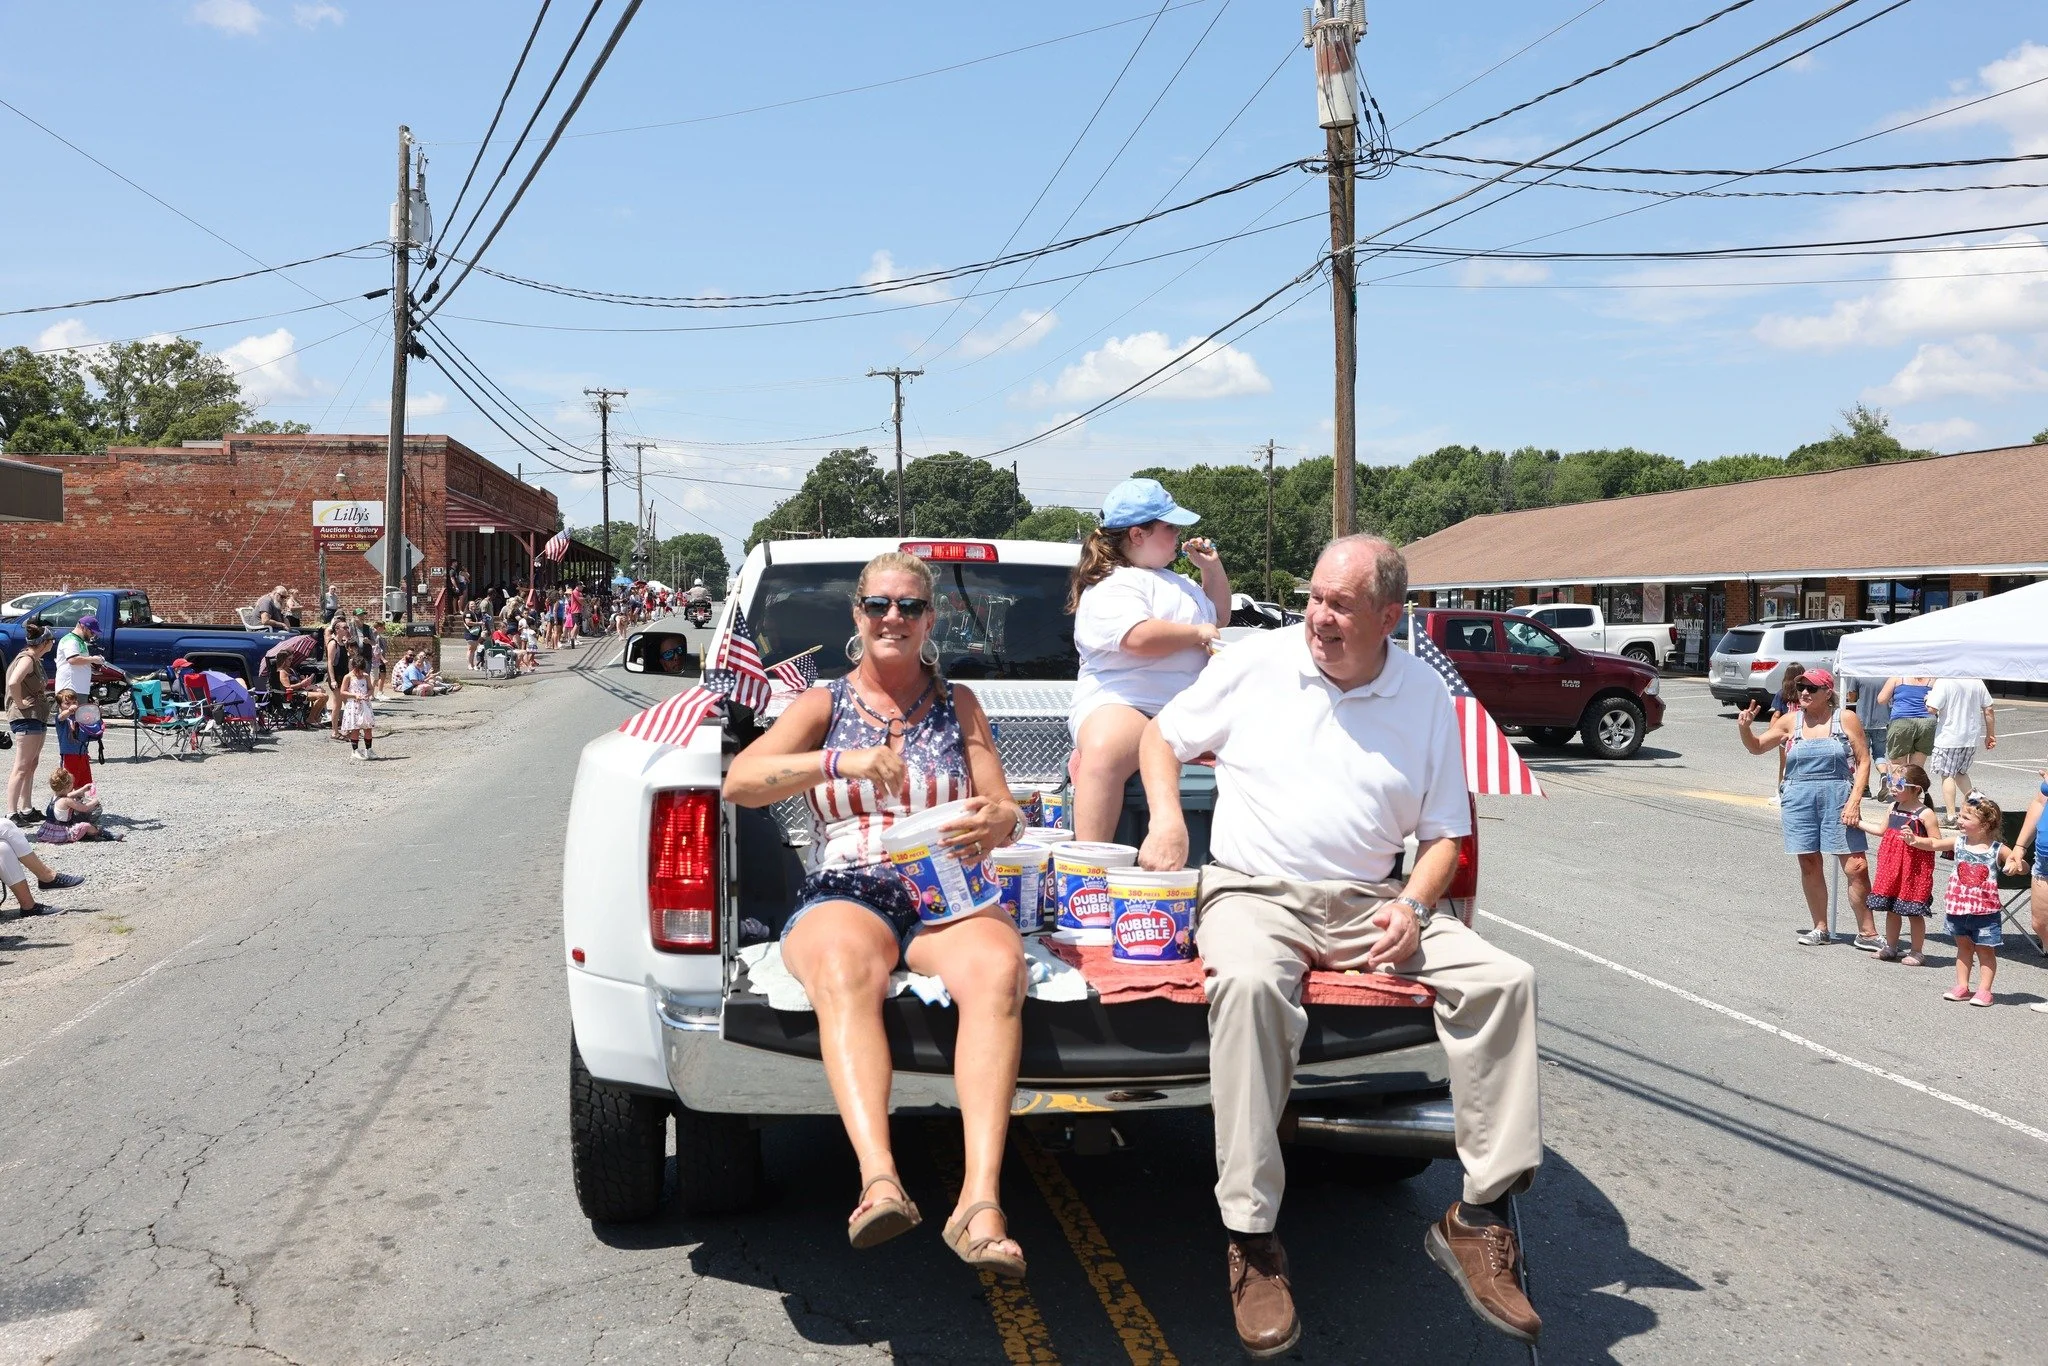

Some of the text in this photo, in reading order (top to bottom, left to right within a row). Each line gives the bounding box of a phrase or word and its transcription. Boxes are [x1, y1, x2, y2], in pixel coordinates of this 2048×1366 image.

[333, 507, 370, 525] Lilly's
[1870, 586, 1886, 595] FedEx
[1674, 619, 1704, 630] TODAY'S CUT
[1072, 893, 1110, 906] DUBB
[1075, 902, 1111, 917] BUBB
[1118, 917, 1168, 933] DUBBLE
[1120, 929, 1171, 945] BUBBLE
